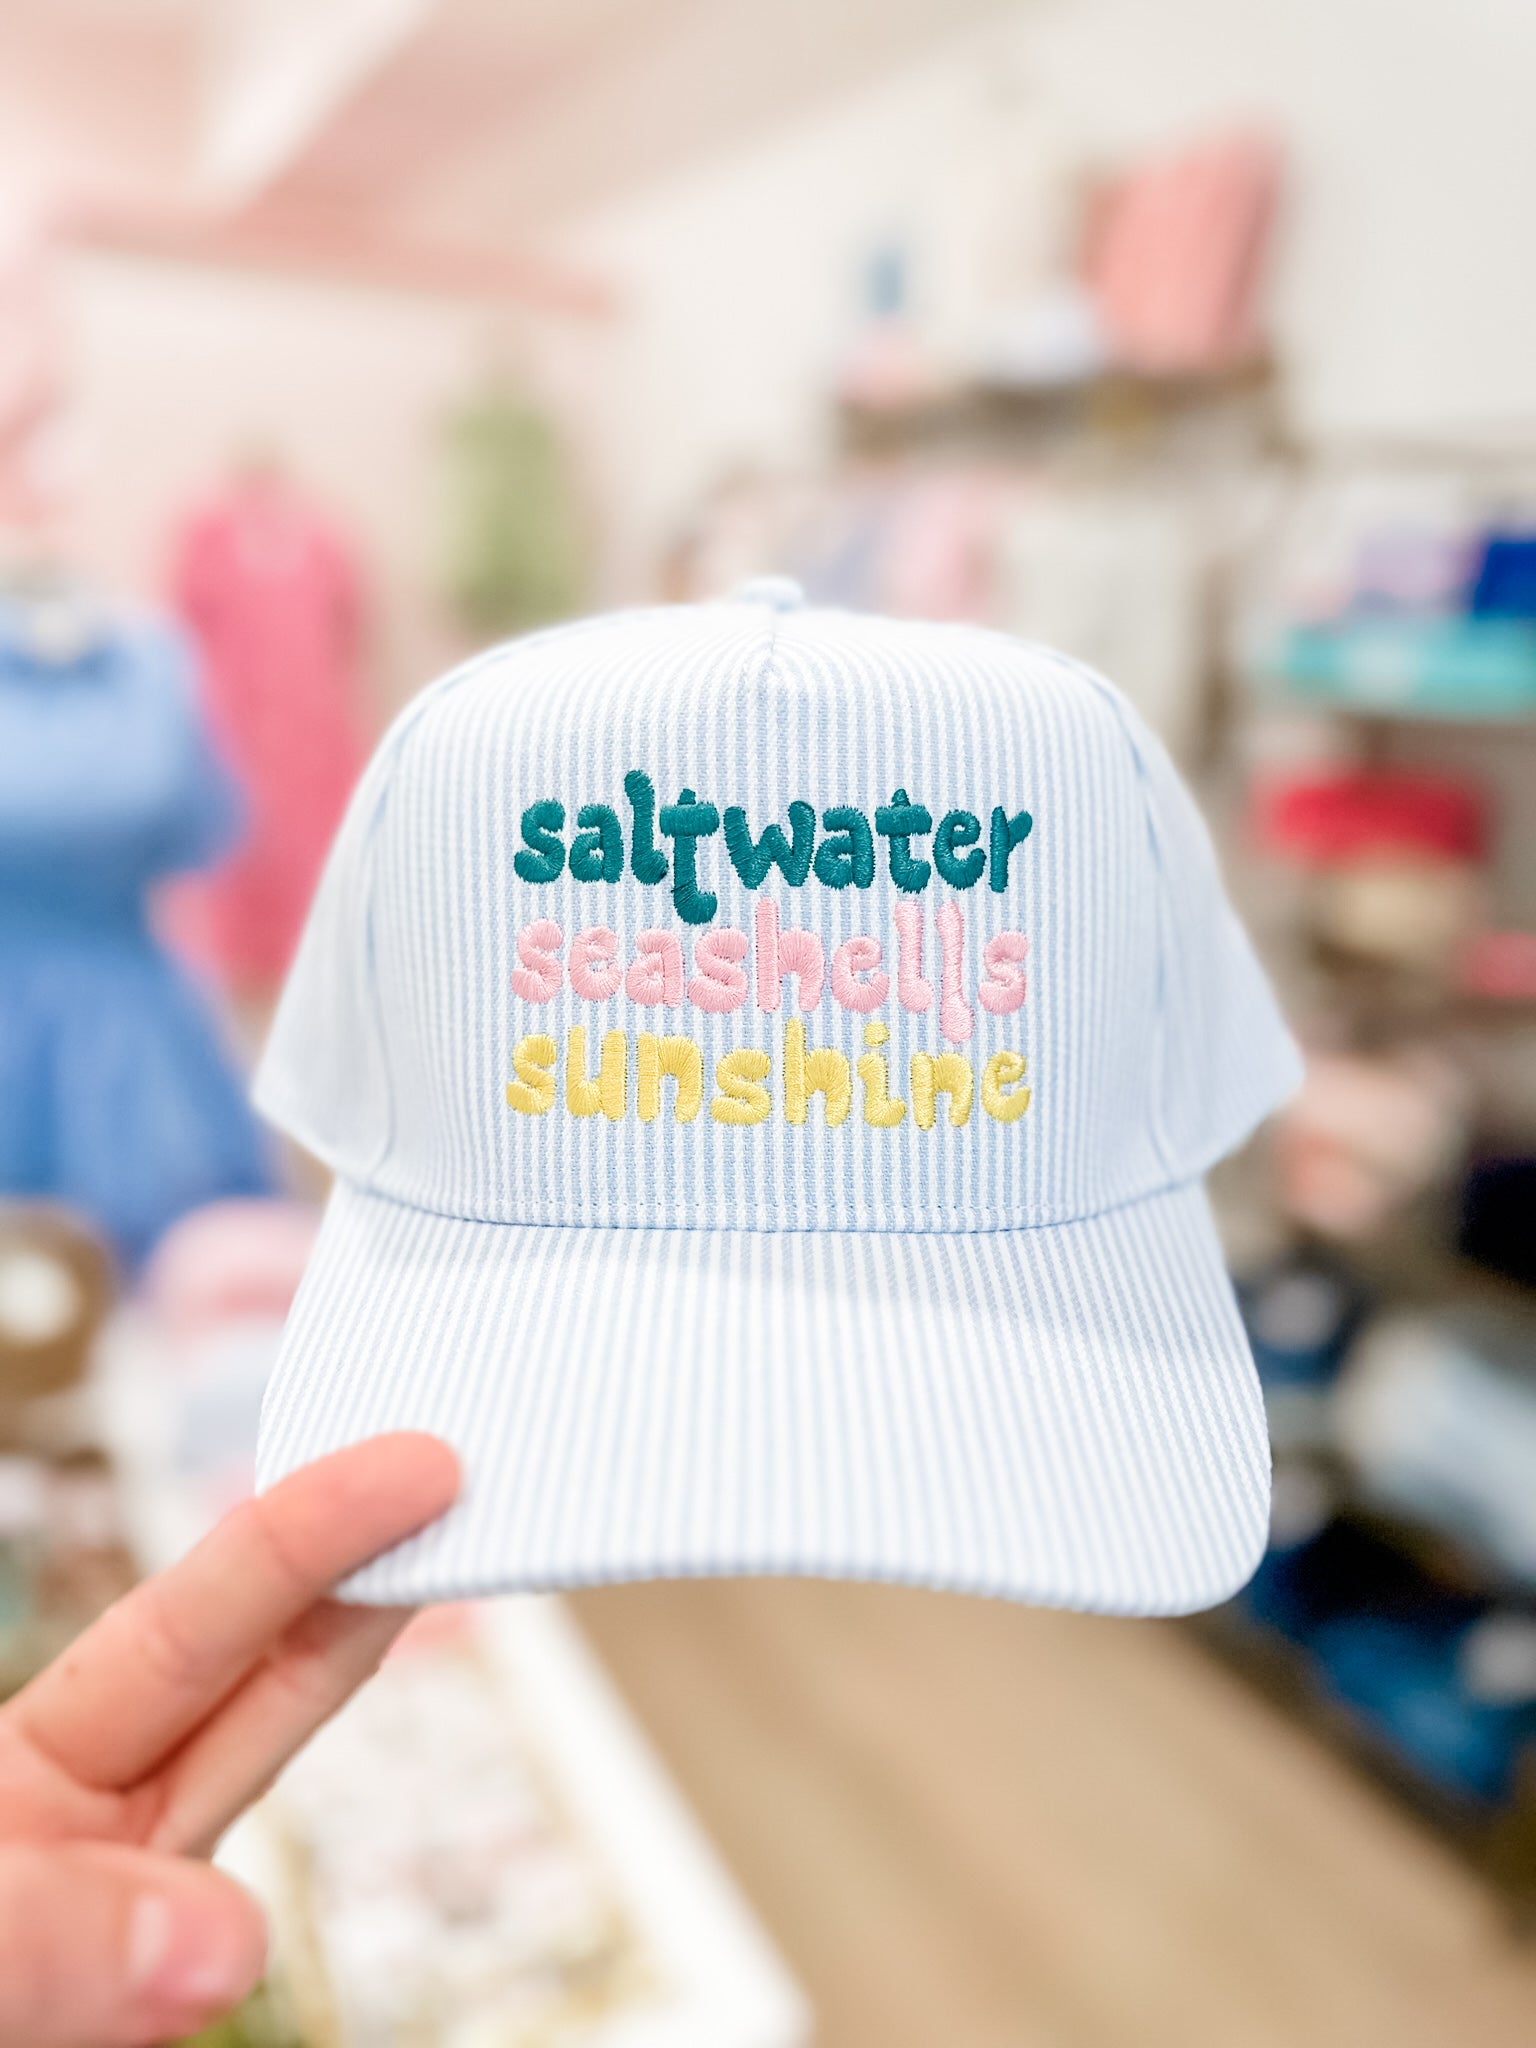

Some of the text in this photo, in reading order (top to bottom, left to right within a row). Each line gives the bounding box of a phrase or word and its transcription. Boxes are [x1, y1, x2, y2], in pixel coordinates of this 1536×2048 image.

[514, 770, 1032, 925] saltwater
[511, 897, 1030, 1043] seashells
[506, 1019, 1031, 1130] sunshine
